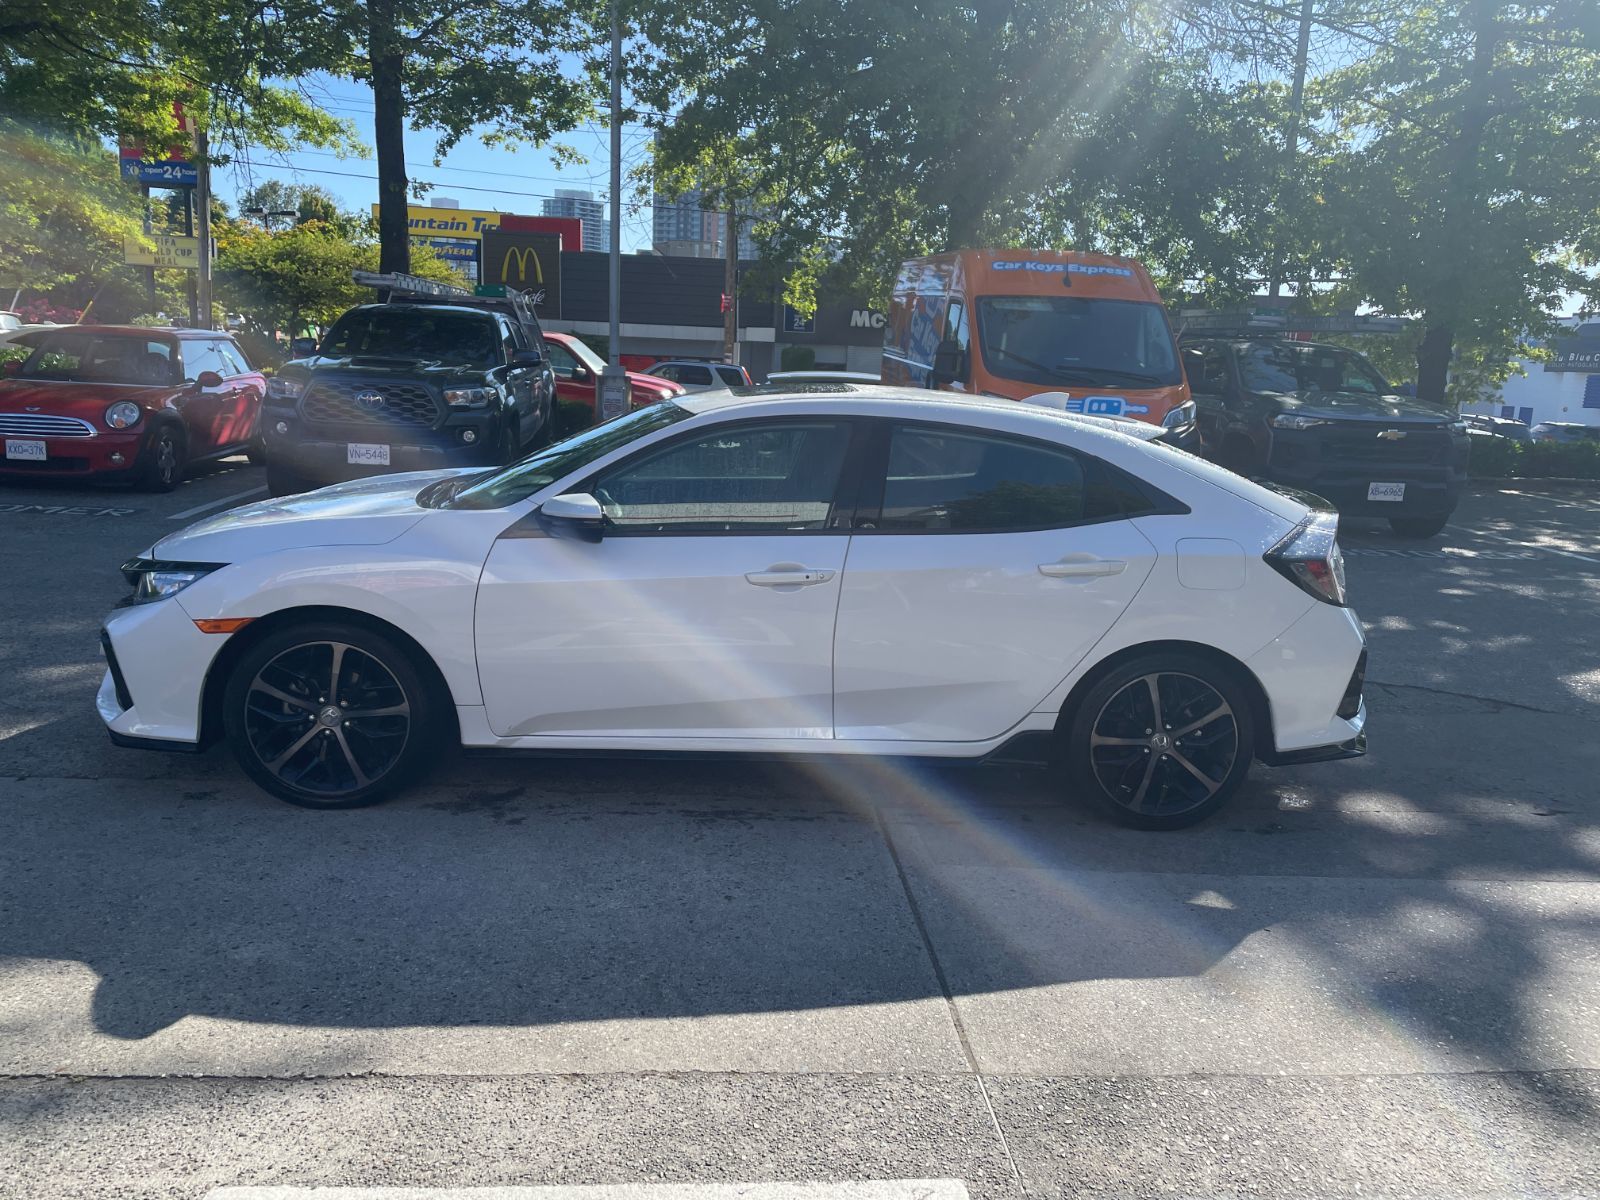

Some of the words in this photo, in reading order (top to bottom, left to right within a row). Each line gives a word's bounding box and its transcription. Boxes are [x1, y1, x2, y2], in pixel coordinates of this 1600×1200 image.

[163, 166, 181, 178] 24
[154, 257, 177, 265] MEAL
[992, 261, 1022, 270] Car
[1025, 262, 1064, 272] Keys
[1068, 264, 1131, 276] Express
[1569, 352, 1591, 362] Blue
